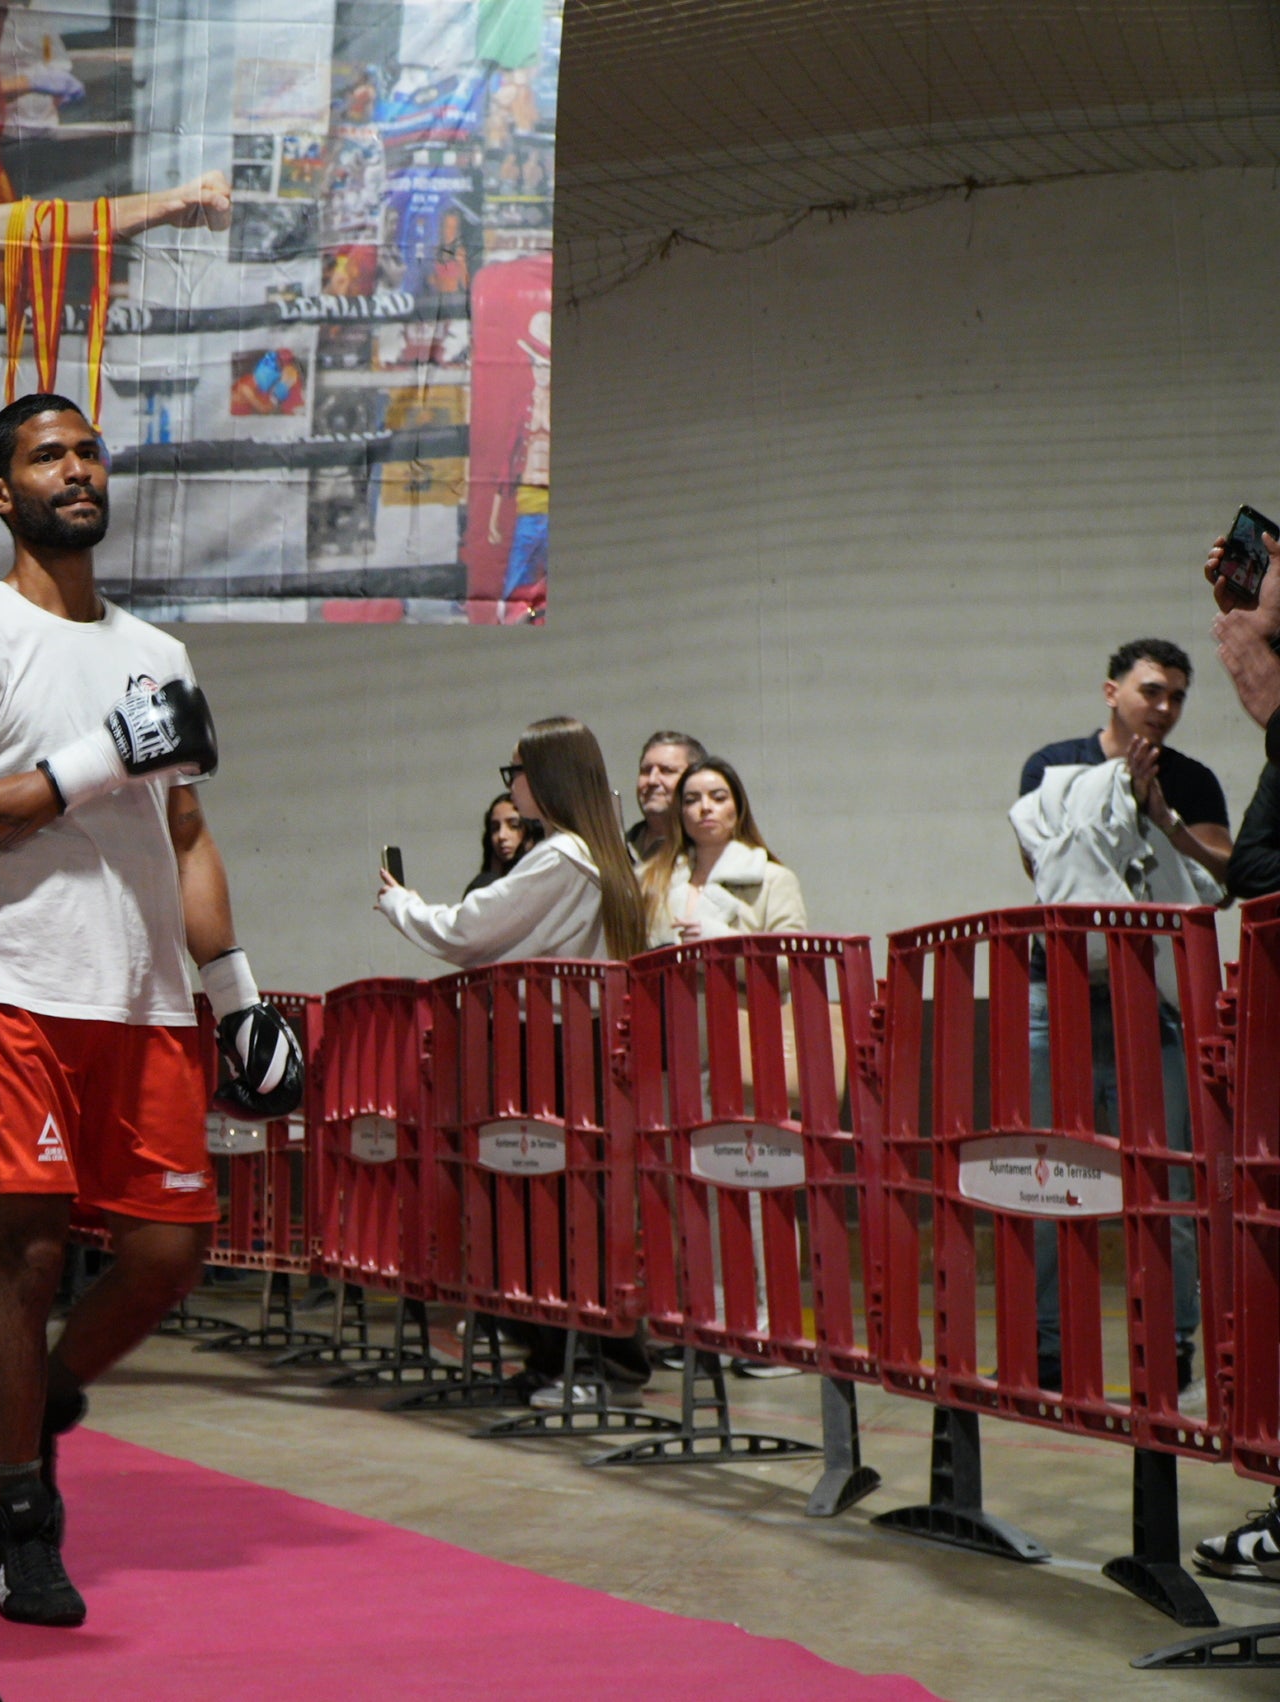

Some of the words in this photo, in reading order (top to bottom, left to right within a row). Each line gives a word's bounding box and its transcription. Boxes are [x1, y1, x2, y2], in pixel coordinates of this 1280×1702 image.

[988, 1160, 1033, 1177] Ajuntament
[1053, 1165, 1064, 1178] de
[1064, 1162, 1102, 1180] Terrassa
[1019, 1190, 1040, 1203] Suport
[1045, 1192, 1069, 1205] entitat
